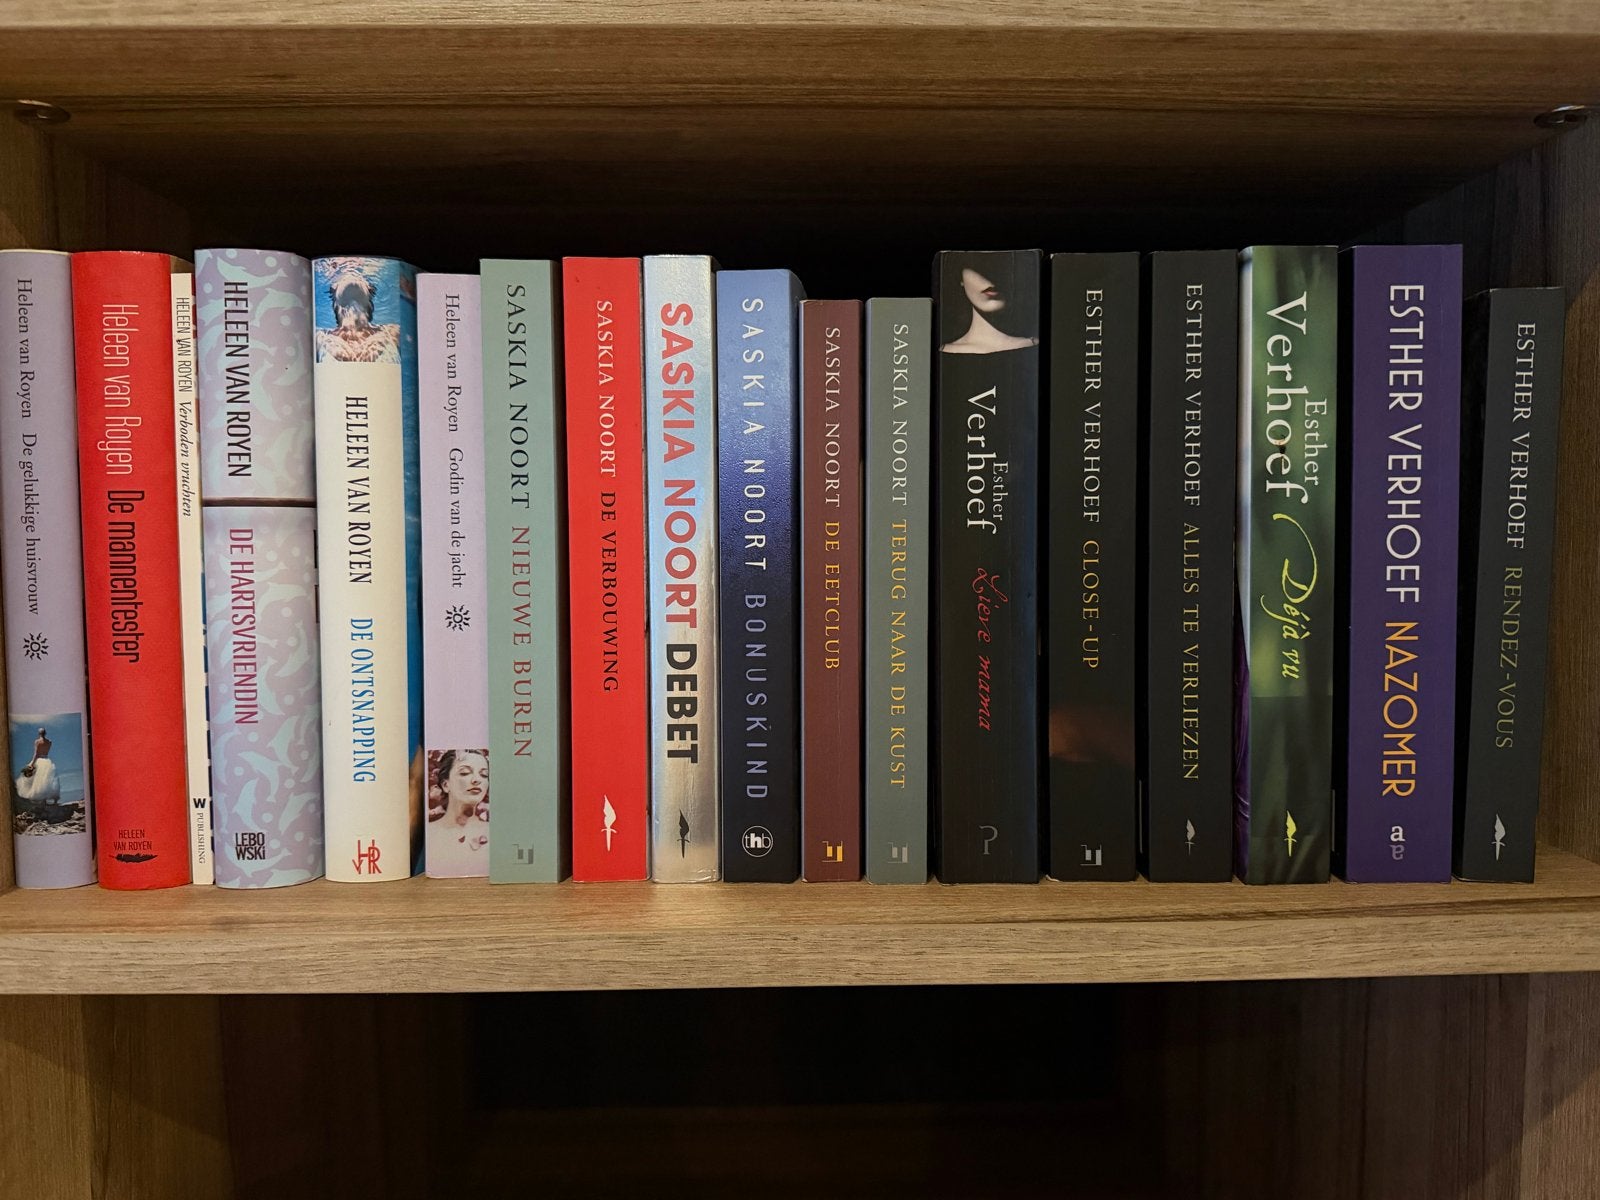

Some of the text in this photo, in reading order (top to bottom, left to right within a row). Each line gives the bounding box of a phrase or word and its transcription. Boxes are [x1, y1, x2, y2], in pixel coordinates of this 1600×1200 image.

[17, 280, 40, 614] Heleen van Royen De gelukkige huisvrouw
[98, 305, 144, 663] Heleen van Royen De mannentester
[176, 298, 195, 517] HELEEN VAN ROYEN Verboden vruchten
[224, 282, 258, 723] HELEEN VAN ROYEN DE HARTSVRIENDIN
[444, 294, 466, 587] Heleen van Royen Godin van de jacht
[507, 285, 531, 756] SASKIA NOORT NIEUWE BUREN
[597, 301, 618, 691] SASKIA NOORT DE VERBOUWING
[661, 303, 698, 763] SASKIA NOORT DEBET
[742, 299, 767, 797] SASKIA NOORT BONUSKIND
[825, 328, 840, 668] SASKIA NOORT DE EETCLUB
[891, 324, 908, 788] SASKIA NOORT TERUG NAAR DE KUST
[967, 386, 1008, 730] Verhoef Lieve mama
[993, 462, 1008, 520] Esther
[1083, 290, 1102, 667] ESTHER VERHOEF CLOSE-UP
[1183, 284, 1202, 778] ESTHER VERHOEF ALLES TE VERLIEZEN
[1261, 291, 1317, 678] Verhoef Déjà vu
[1305, 399, 1327, 485] Esther
[1383, 285, 1424, 796] ESTHER VERHOEF NAZOMER
[1496, 323, 1535, 747] ESTHER VERHOEF RENDEZ-VOUS
[346, 397, 376, 781] HELEEN VAN ROYEN DE ONTSNAPPING
[113, 840, 152, 851] VAN ROYEN
[119, 829, 144, 840] HELEEN
[193, 798, 206, 808] W
[235, 833, 266, 846] LEBO
[745, 833, 771, 848] thb
